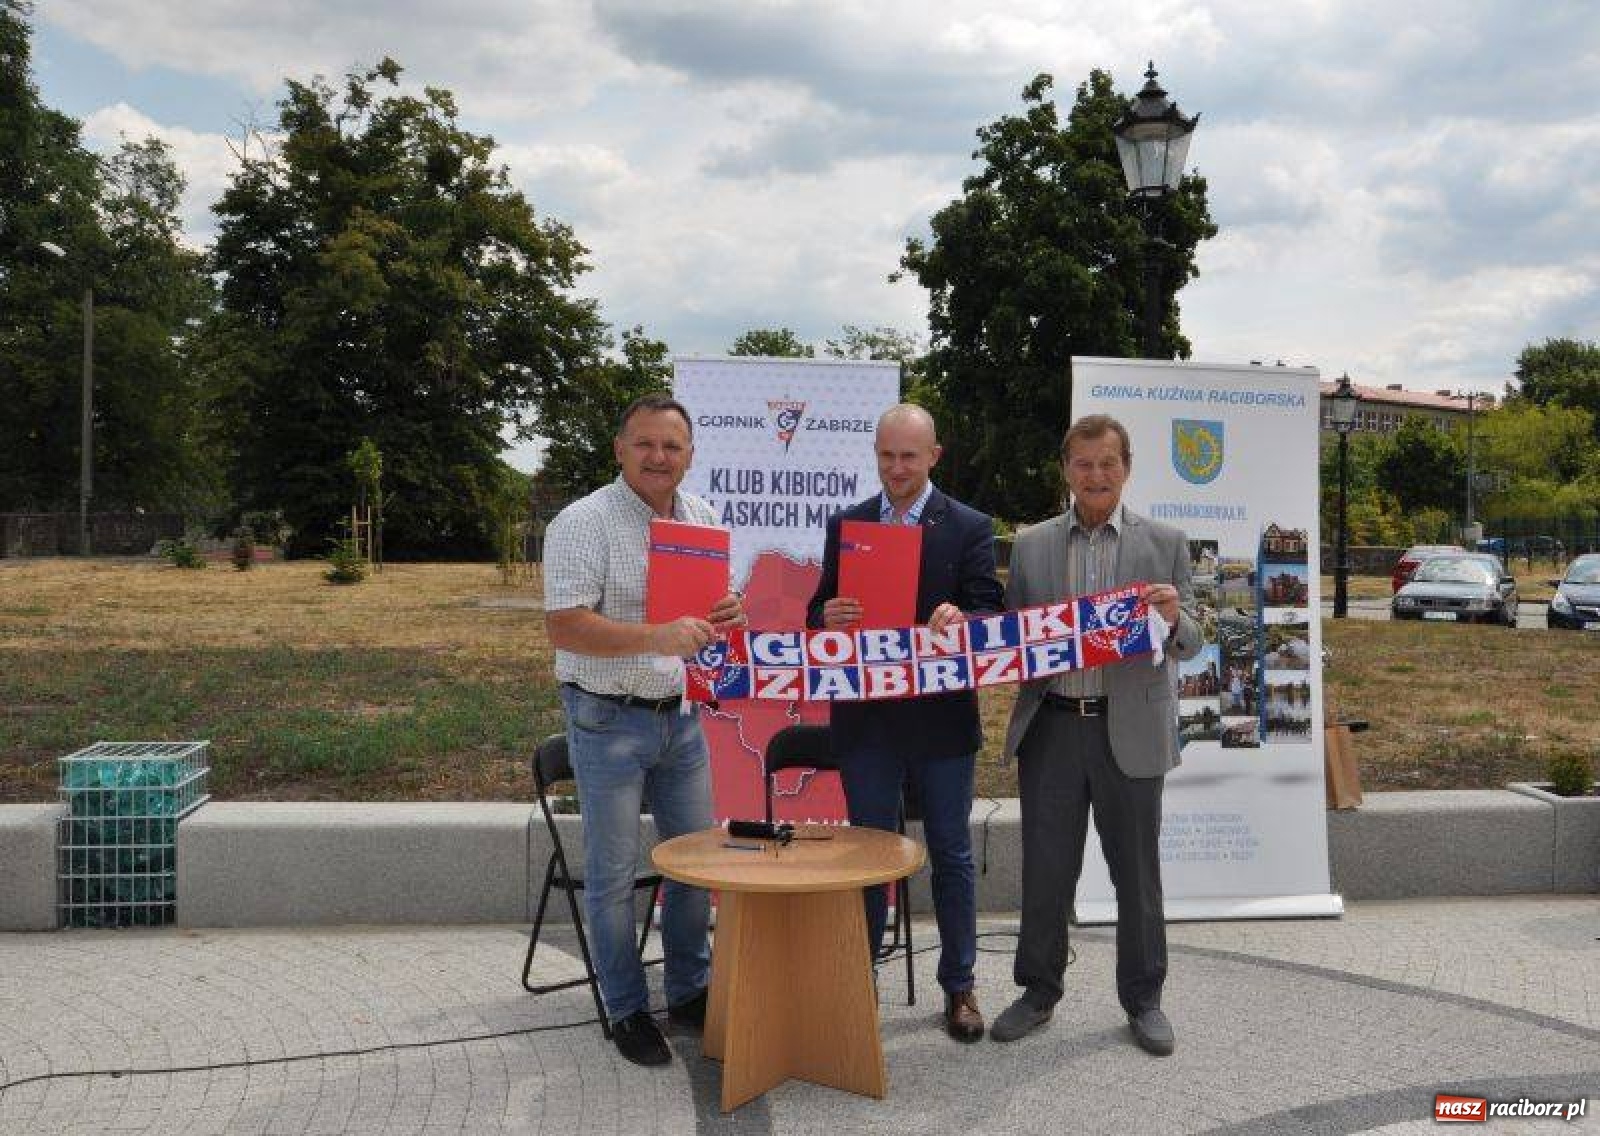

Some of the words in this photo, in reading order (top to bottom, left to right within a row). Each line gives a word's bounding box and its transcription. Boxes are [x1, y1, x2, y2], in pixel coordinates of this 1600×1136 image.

[1091, 385, 1142, 399] GMINA
[1207, 389, 1305, 408] RACIBORSKA
[804, 418, 874, 433] ZABRZE
[709, 468, 764, 495] KLUB
[770, 467, 858, 497] KIBICÓW
[756, 641, 1072, 700] ZABRZE
